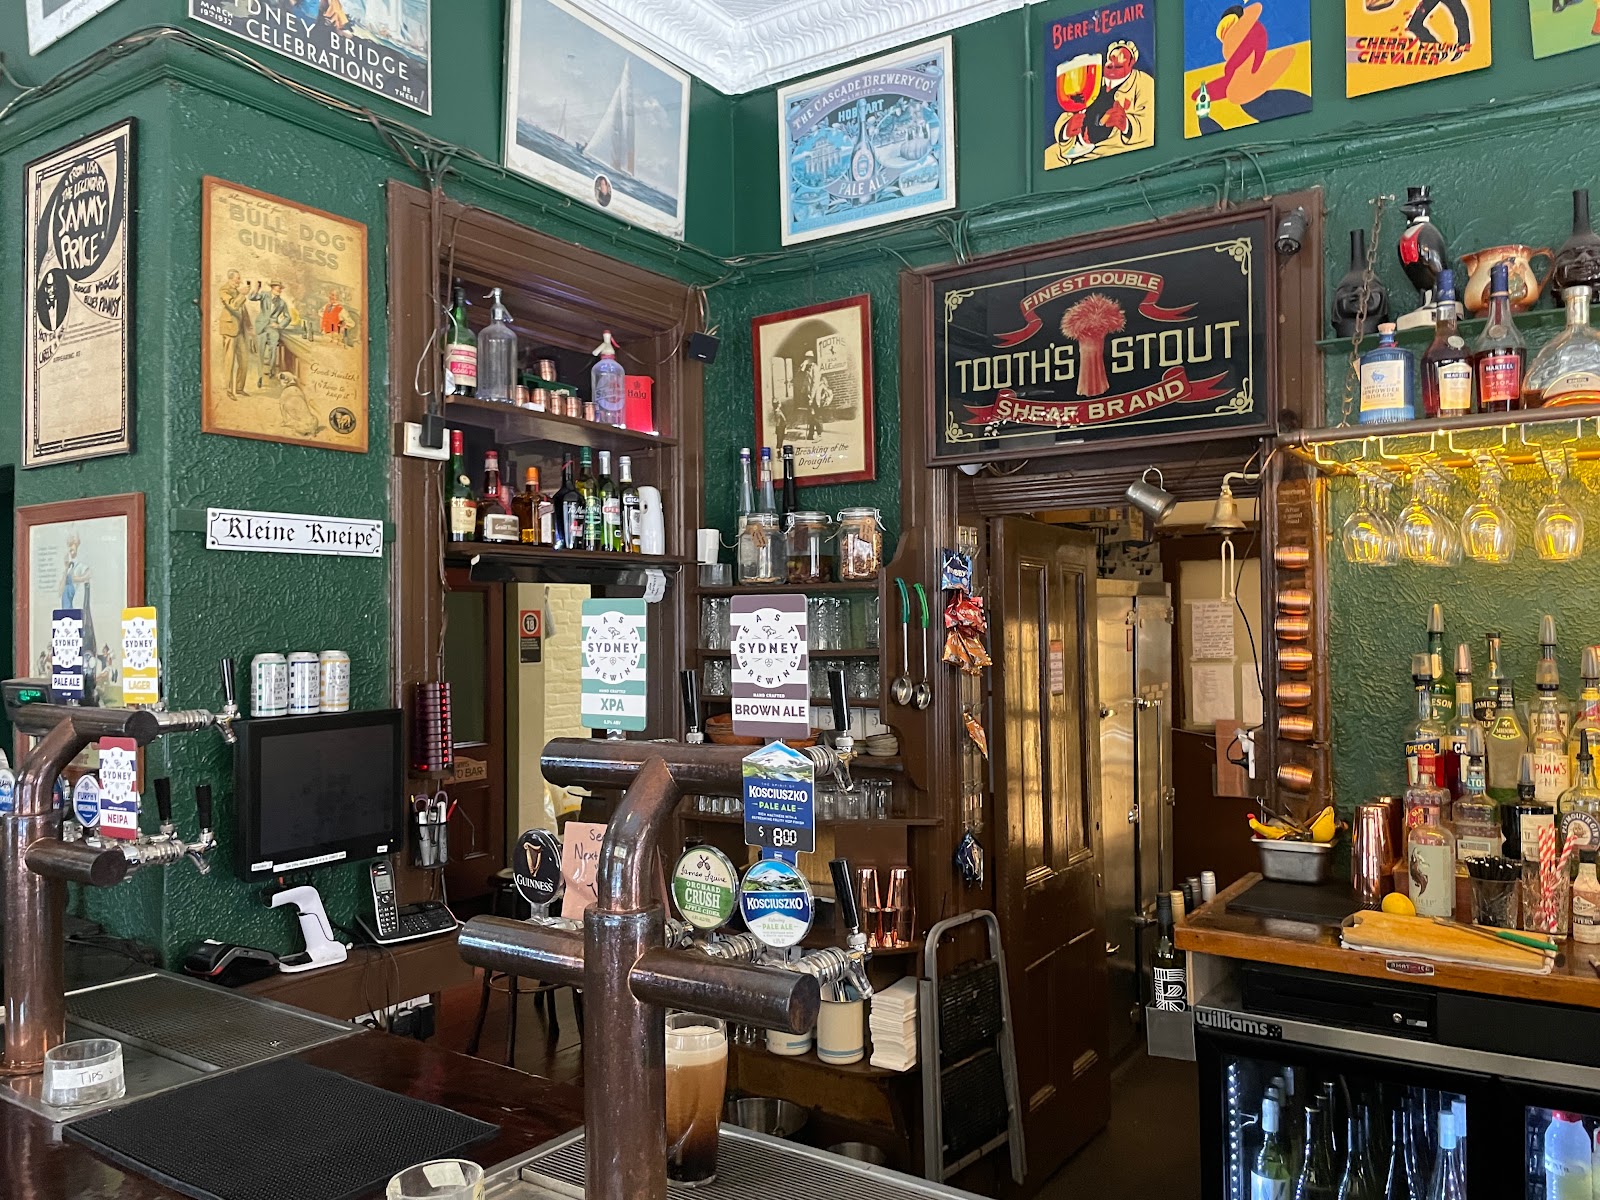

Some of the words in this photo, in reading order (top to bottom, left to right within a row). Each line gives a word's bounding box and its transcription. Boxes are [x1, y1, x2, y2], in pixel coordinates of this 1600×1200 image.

[1355, 37, 1420, 51] CHERRY
[1419, 41, 1473, 53] MAURICE
[246, 18, 384, 90] CELEBRATIONS
[331, 32, 409, 81] BRIDGE
[1357, 51, 1440, 66] CHEVALIER
[402, 85, 411, 94] BE
[792, 109, 815, 130] THE
[814, 80, 862, 113] CASCADE
[862, 73, 916, 89] BREWERY
[838, 180, 865, 197] PALE
[868, 172, 889, 193] ALE
[58, 196, 107, 238] SAMMY
[229, 204, 288, 236] BULL
[299, 224, 346, 252] DOG
[60, 233, 100, 270] PRICE
[238, 229, 339, 270] GUINNESS
[1022, 276, 1086, 312] FINEST
[1089, 272, 1162, 291] DOUBLE
[955, 342, 1075, 394] TOOTH'S
[1111, 320, 1240, 374] STOUT
[1485, 363, 1514, 372] MARTELL
[996, 399, 1079, 425] SHEAF
[1088, 379, 1185, 421] BRAND
[795, 445, 828, 458] Breaking
[222, 516, 296, 542] Kleine
[305, 522, 374, 550] Kneipe
[525, 620, 535, 631] 18
[592, 616, 636, 635] EAST
[742, 613, 796, 635] EAST
[55, 639, 79, 647] SYDNEY
[125, 639, 154, 648] SYDNEY
[587, 642, 639, 653] SYDNEY
[738, 642, 799, 654] SYDNEY
[590, 659, 637, 681] BREWING
[741, 659, 797, 685] BREWING
[53, 677, 69, 686] PALE
[68, 678, 80, 687] ALE
[128, 680, 151, 690] LAGER
[600, 698, 625, 712] XPA
[735, 704, 781, 717] BROWN
[782, 705, 806, 718] ALE
[1454, 743, 1467, 754] CA
[103, 770, 132, 781] SYDNEY
[465, 766, 485, 779] BAR
[1535, 762, 1567, 775] PIMM'S
[748, 785, 809, 803] KOSCIUSZKO
[758, 801, 780, 811] PALE
[780, 803, 797, 812] ALE
[107, 813, 129, 826] NEIPA
[1561, 812, 1592, 834] PLYMOUTH
[1589, 822, 1600, 838] GIN
[758, 825, 765, 837] $
[574, 842, 599, 861] Next
[680, 864, 703, 878] James
[516, 873, 554, 894] GUINNESS
[686, 880, 721, 893] ORCHARD
[685, 887, 721, 910] CRUSH
[746, 897, 804, 910] KOSCIUSZKO
[684, 904, 702, 914] APPLE
[1195, 1010, 1269, 1036] williams
[76, 1069, 104, 1086] TIPS
